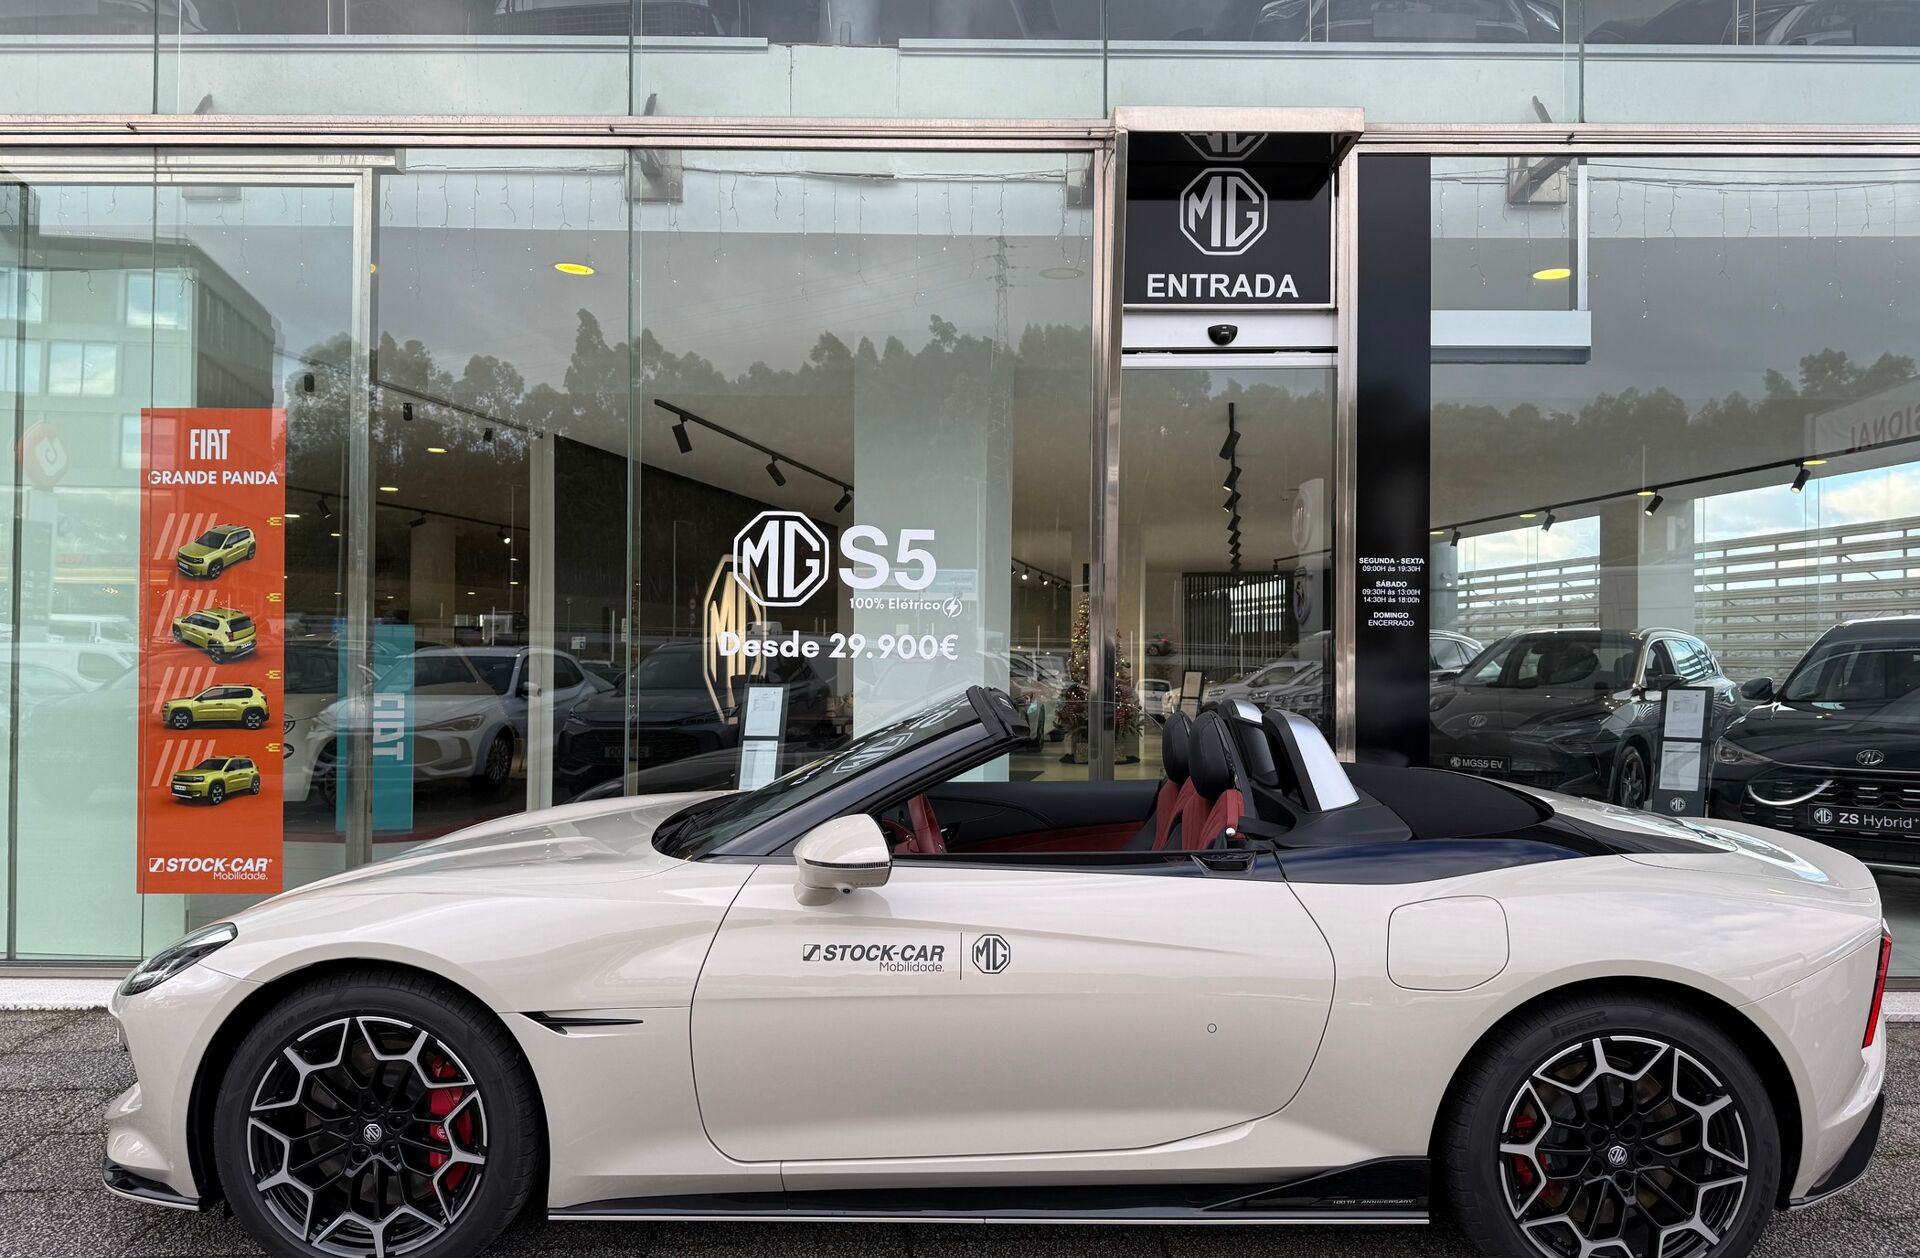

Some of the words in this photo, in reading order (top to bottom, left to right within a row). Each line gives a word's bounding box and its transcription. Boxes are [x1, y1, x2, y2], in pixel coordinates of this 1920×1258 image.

[1184, 172, 1263, 251] MG
[1147, 273, 1299, 298] ENTRADA
[189, 428, 231, 460] FIAT
[147, 470, 217, 485] GRANDE
[222, 470, 278, 485] PANDA
[739, 515, 824, 602] MG
[839, 525, 937, 590] S5
[1375, 580, 1407, 588] SÁBADO
[849, 597, 885, 610] 100%
[888, 597, 941, 611] Elétrico
[719, 630, 820, 658] Desde
[828, 633, 959, 660] 29.900€
[373, 692, 404, 760] FIAT
[1462, 759, 1489, 768] MGS5
[1490, 760, 1503, 769] EV
[1670, 798, 1685, 812] MG
[1815, 808, 1832, 824] MG
[1839, 812, 1859, 824] ZS
[166, 857, 272, 872] STOCK-CAR
[213, 872, 269, 880] Mobilidade.
[823, 944, 945, 962] STOCK-CAR
[974, 936, 1008, 972] MG
[879, 961, 945, 973] Mobilidade.
